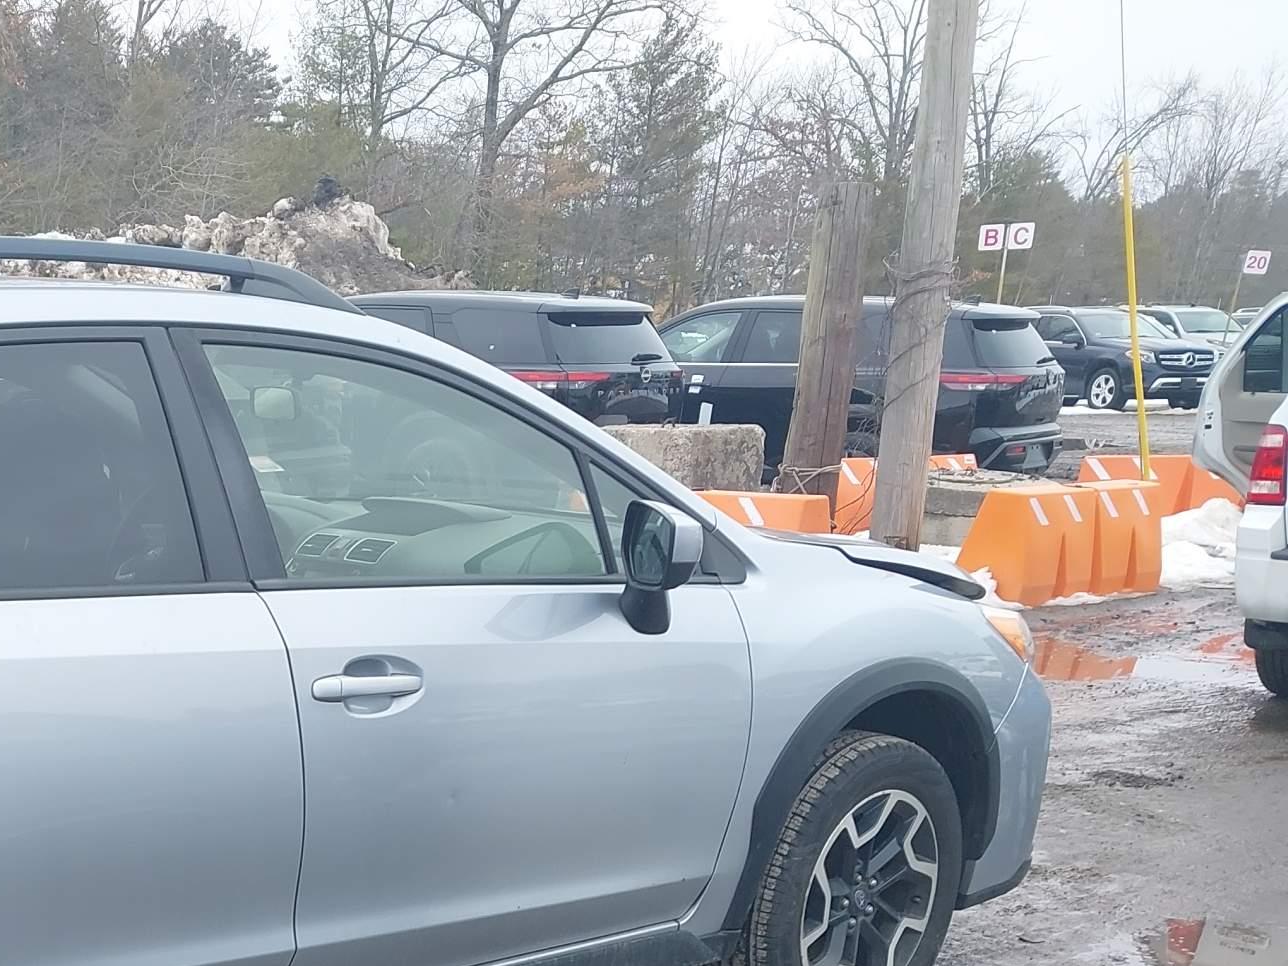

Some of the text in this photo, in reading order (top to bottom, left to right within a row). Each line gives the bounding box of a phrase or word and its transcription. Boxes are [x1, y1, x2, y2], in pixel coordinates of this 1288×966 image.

[984, 228, 999, 246] B
[1013, 226, 1029, 245] C
[1246, 255, 1267, 270] 20
